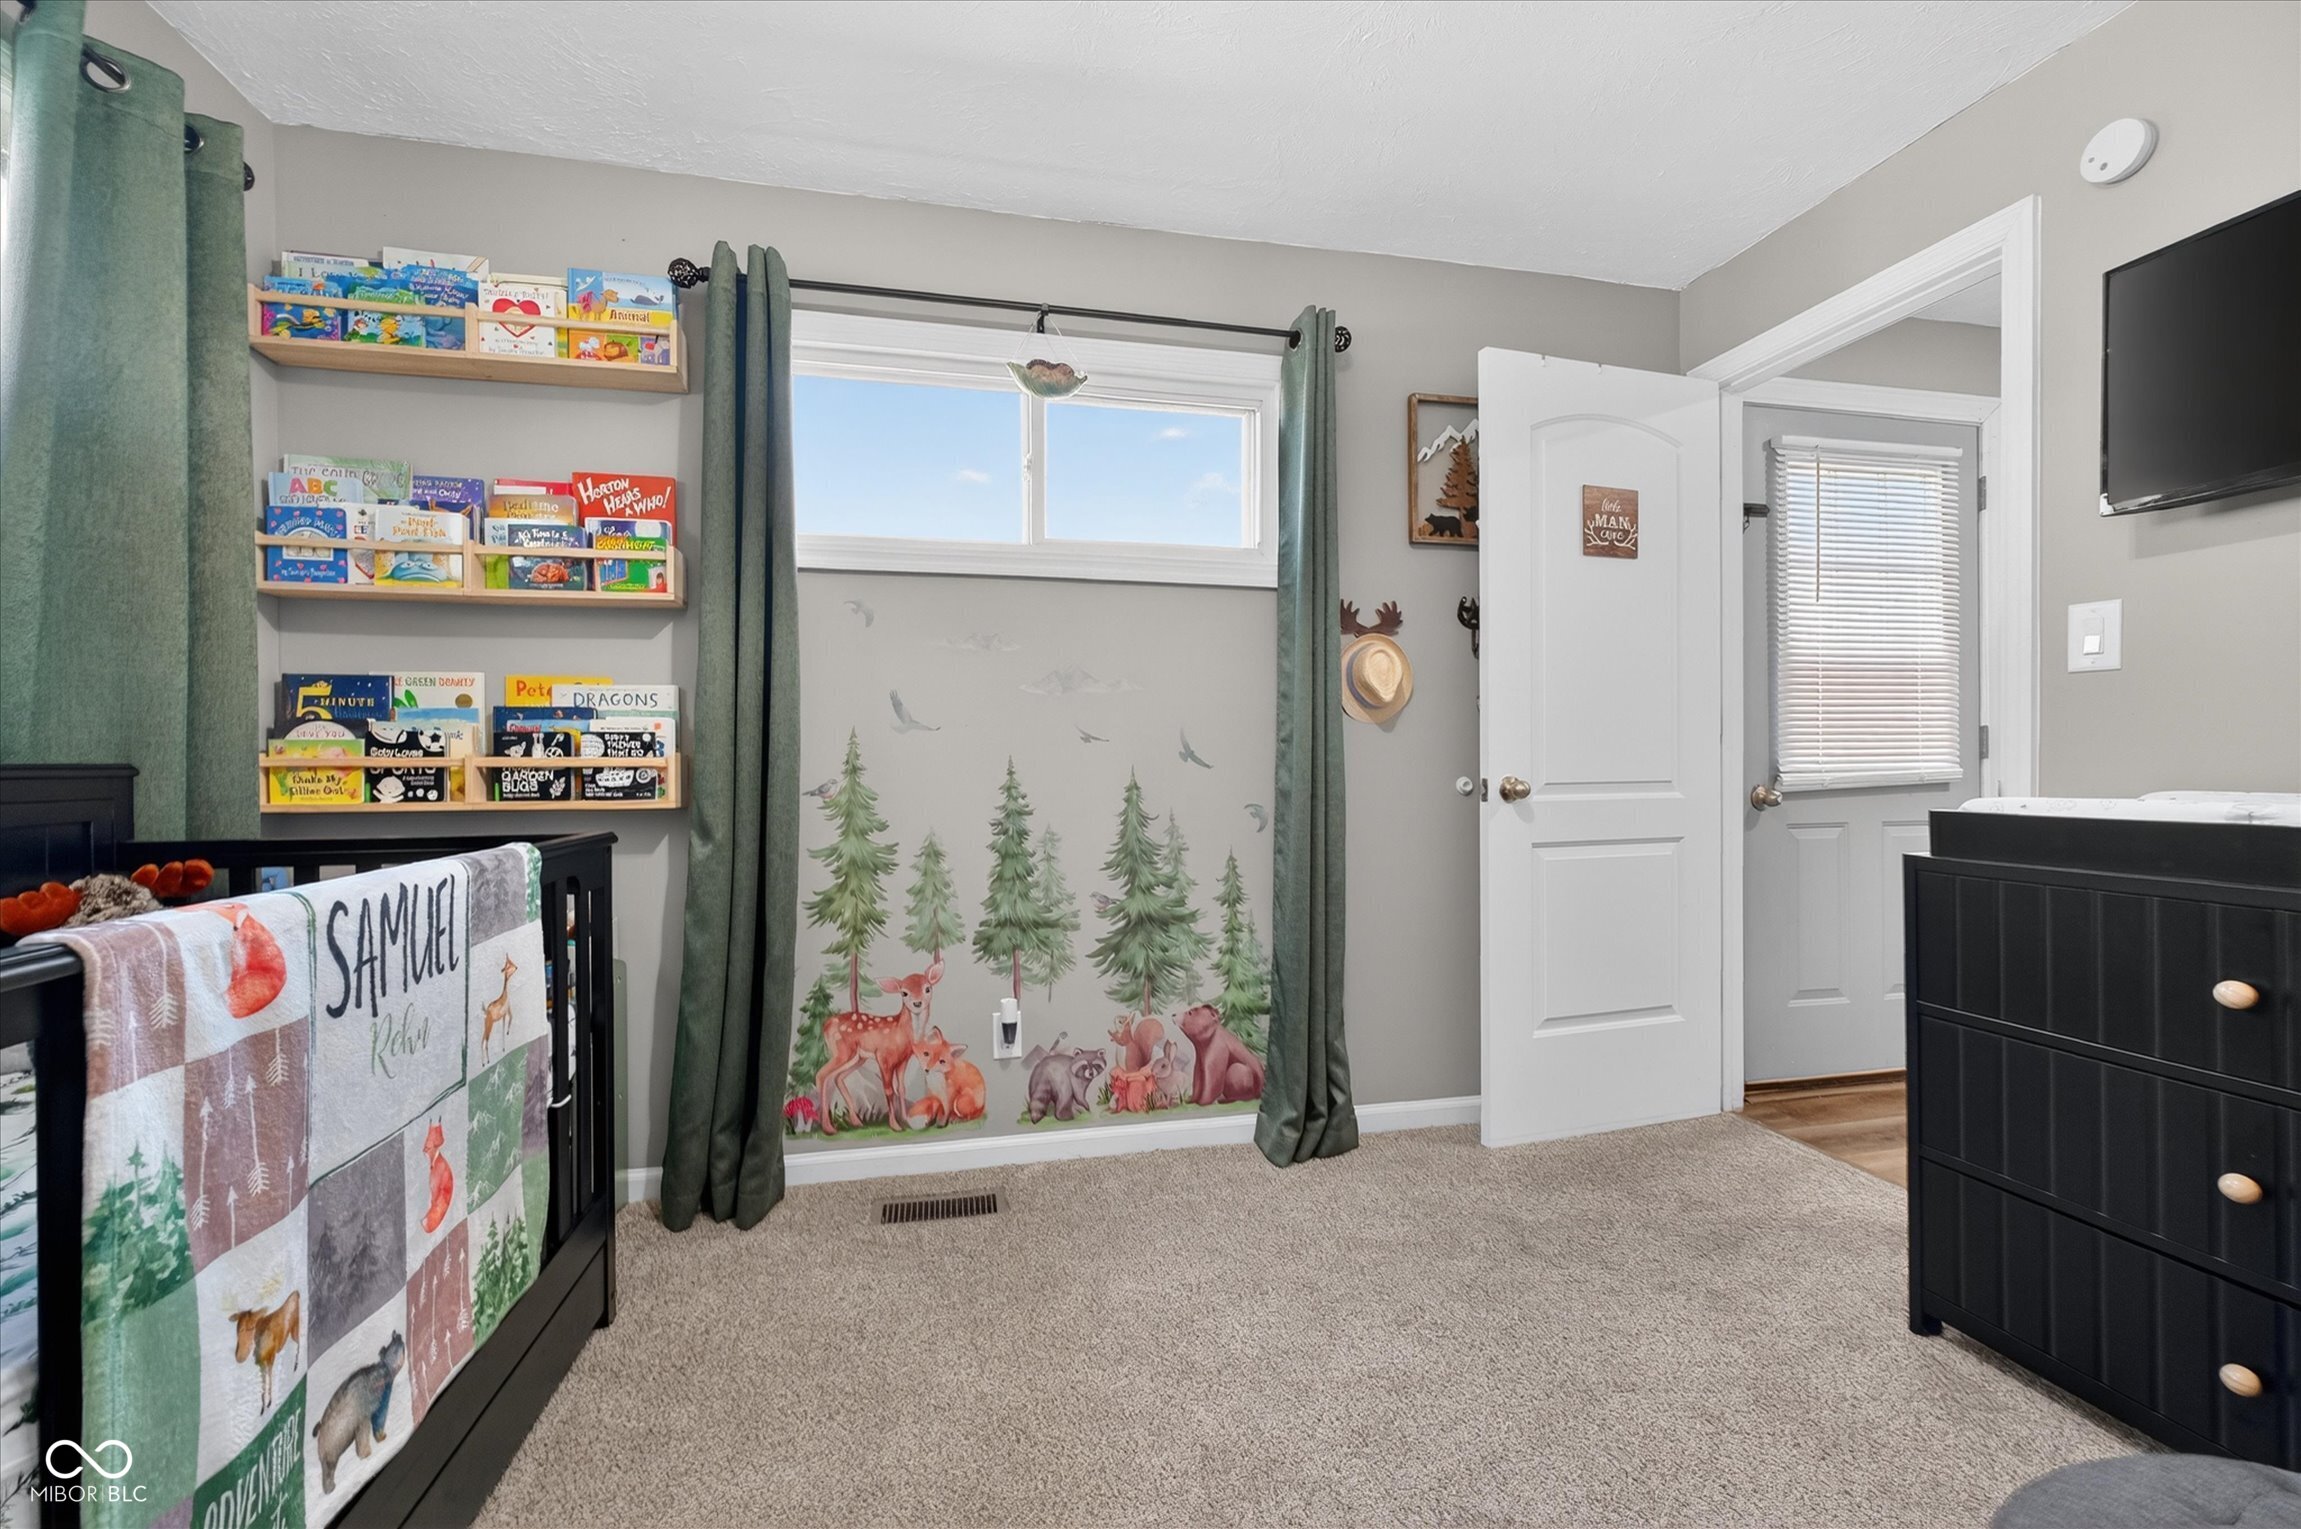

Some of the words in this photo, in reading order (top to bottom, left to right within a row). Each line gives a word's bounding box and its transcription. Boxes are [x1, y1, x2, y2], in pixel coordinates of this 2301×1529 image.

[609, 309, 649, 322] Animal
[289, 477, 338, 496] ABC
[577, 477, 630, 505] HORTON
[603, 488, 641, 516] HEARS
[632, 486, 672, 516] WHO!
[1595, 513, 1631, 530] MAN
[405, 676, 437, 687] GREEN
[296, 682, 333, 719] 5
[573, 692, 658, 708] DRAGONS
[325, 730, 345, 738] YOU
[501, 769, 554, 782] GARDEN
[502, 780, 538, 792] BUGS
[326, 873, 459, 1018] SAMUEL
